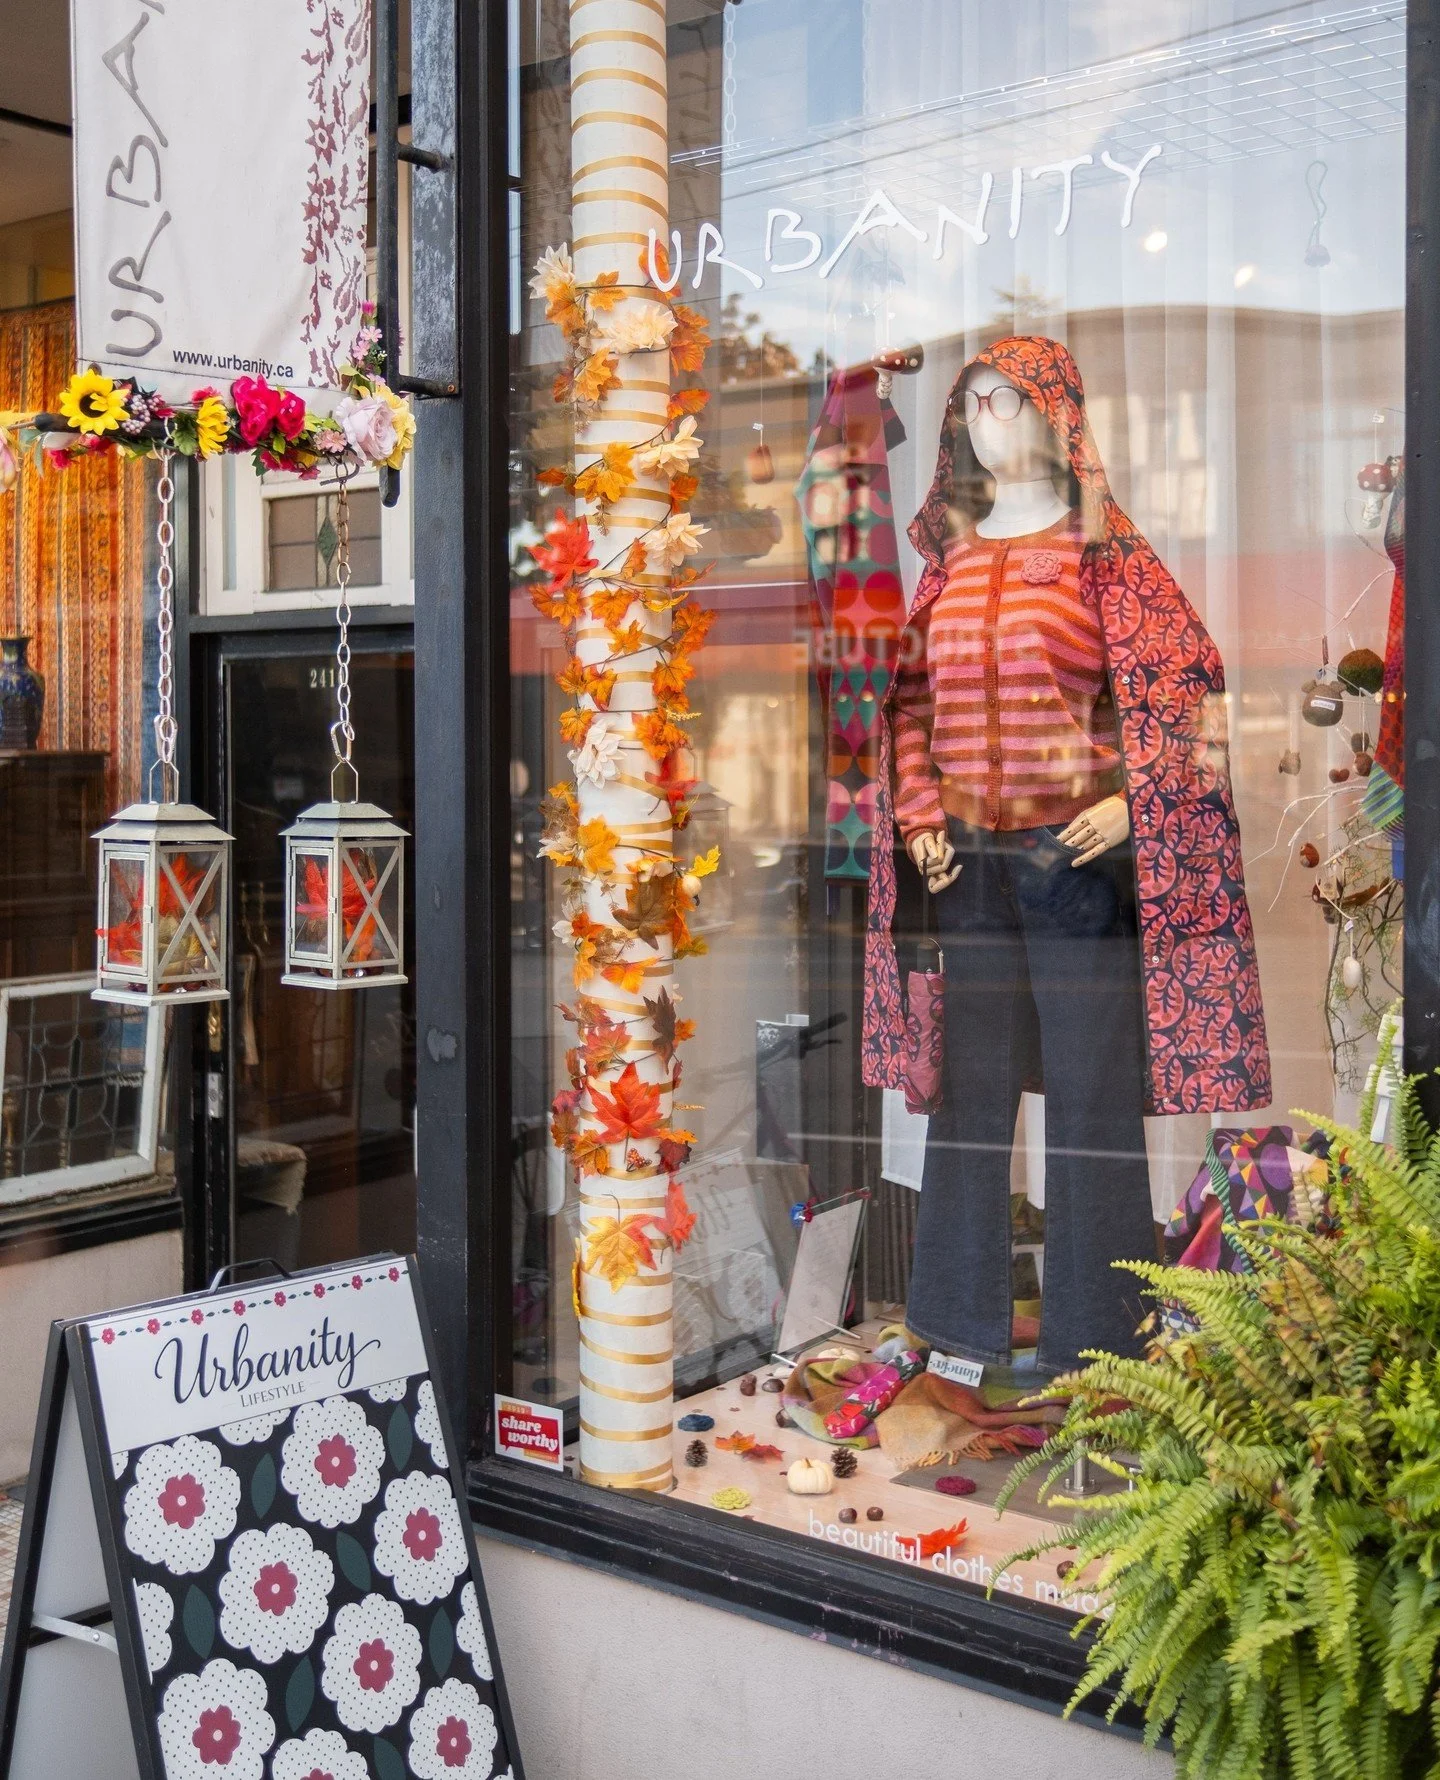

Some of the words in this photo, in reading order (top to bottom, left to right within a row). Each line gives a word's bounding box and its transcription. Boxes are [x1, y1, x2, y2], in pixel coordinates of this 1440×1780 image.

[102, 0, 172, 358] URBA
[648, 144, 1163, 292] URBANITY
[172, 349, 294, 379] www.urbanity.ca
[154, 1316, 381, 1404] Urbanity
[240, 1380, 306, 1408] LIFESTYLE
[501, 1416, 541, 1433] share
[507, 1431, 559, 1452] worthy
[808, 1507, 921, 1566] beautiful
[931, 1546, 1024, 1595] clothes
